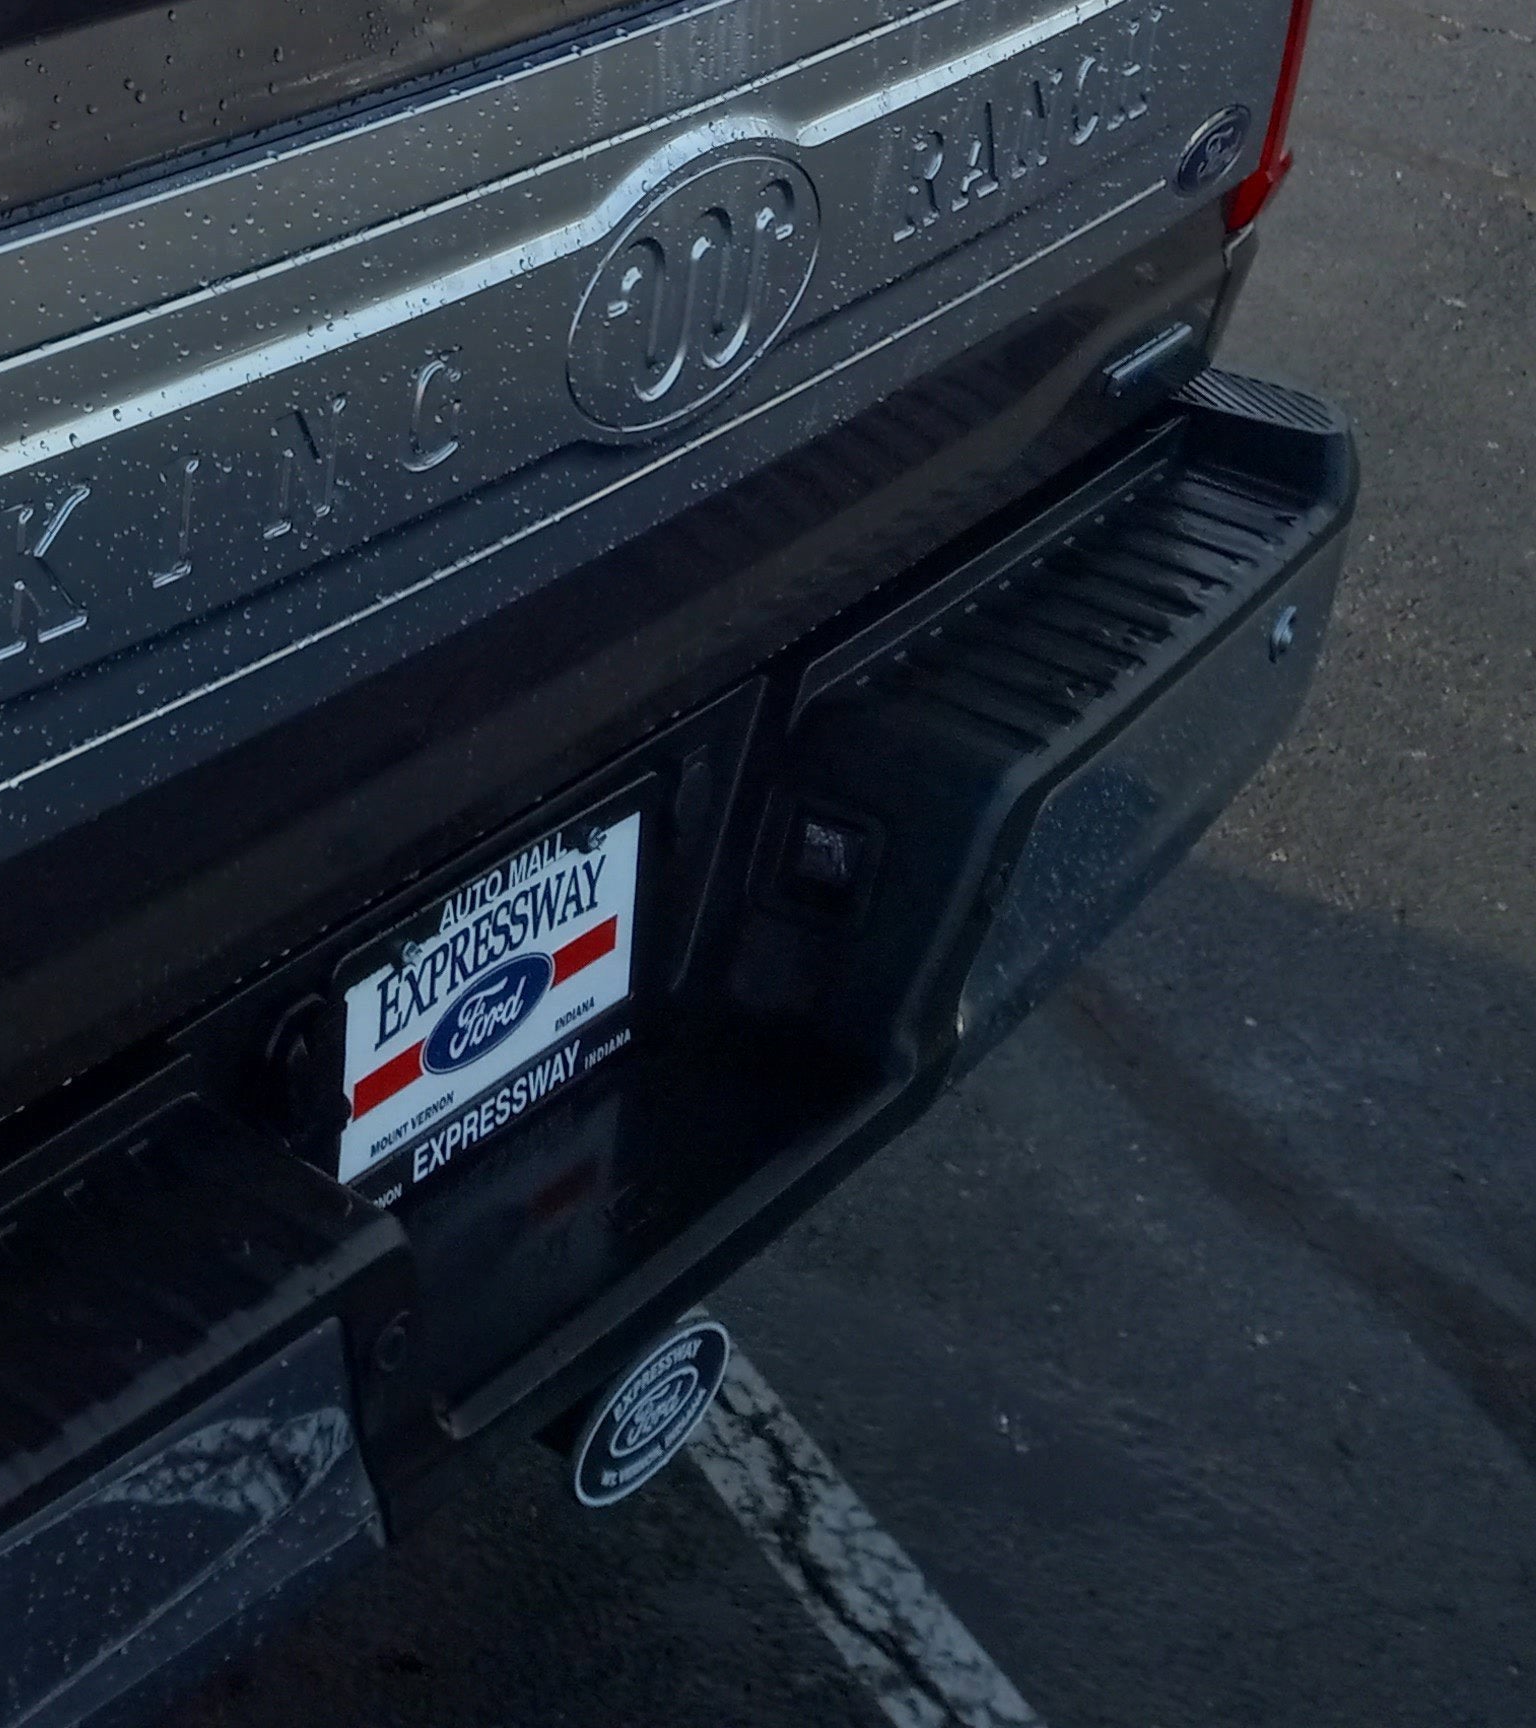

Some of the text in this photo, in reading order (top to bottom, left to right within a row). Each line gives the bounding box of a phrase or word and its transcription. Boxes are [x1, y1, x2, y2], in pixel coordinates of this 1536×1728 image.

[439, 831, 567, 933] AUTO MALL
[374, 854, 607, 1052] EXPRESSWAY
[449, 975, 526, 1060] Ford
[555, 995, 595, 1032] INDIANA
[370, 1091, 455, 1158] MOUNT VERNON
[412, 1038, 581, 1184] EXPRESSWAY
[584, 1027, 631, 1070] INDIANA
